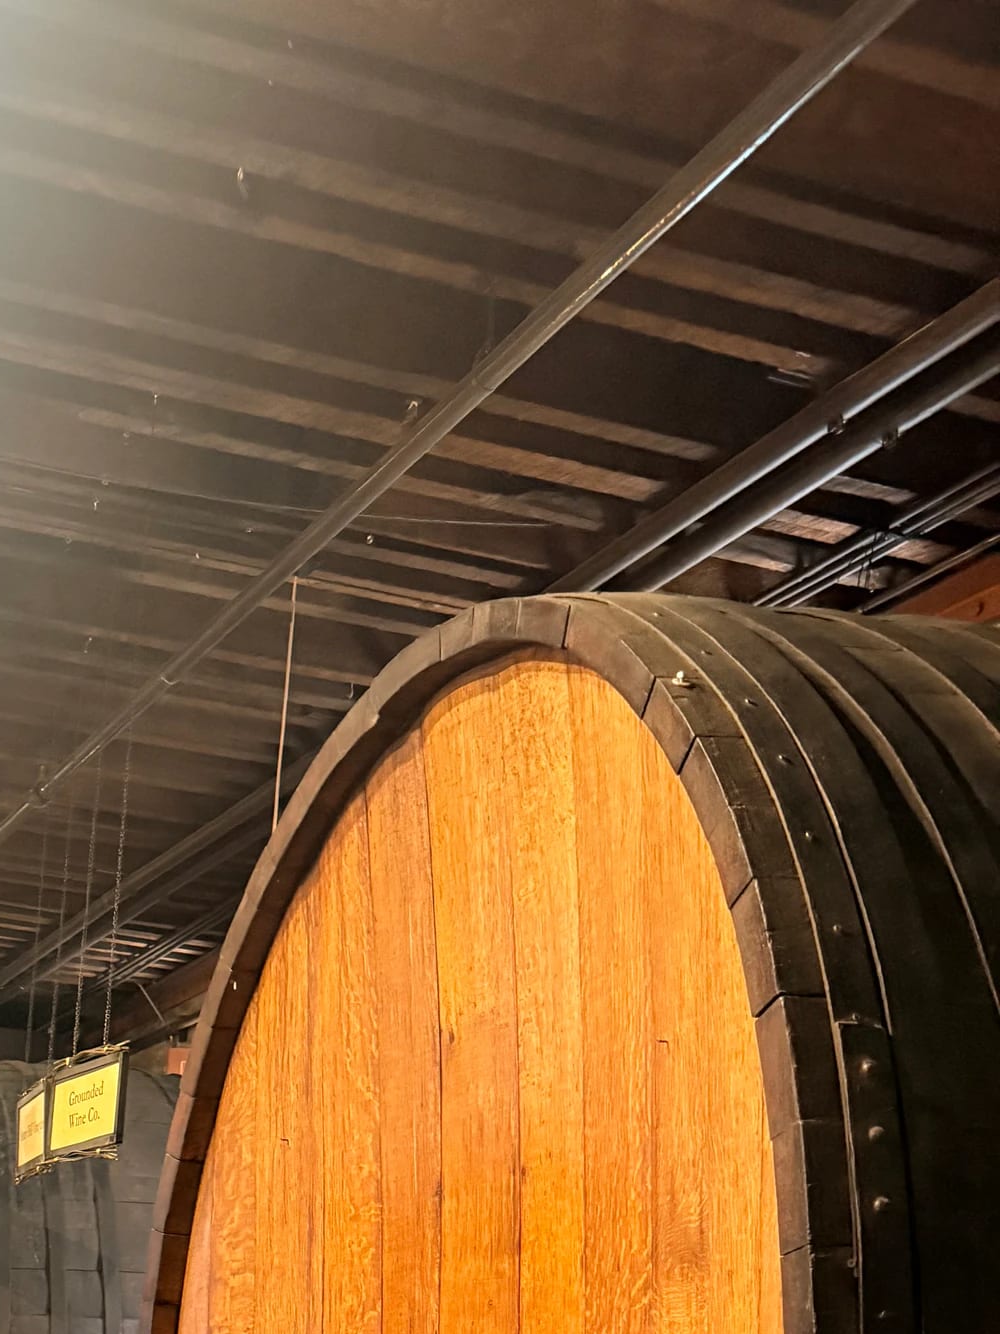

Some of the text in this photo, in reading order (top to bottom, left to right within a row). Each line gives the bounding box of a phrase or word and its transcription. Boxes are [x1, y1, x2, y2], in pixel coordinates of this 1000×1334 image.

[69, 1080, 104, 1106] Grounded
[69, 1107, 101, 1128] Wine Co.
